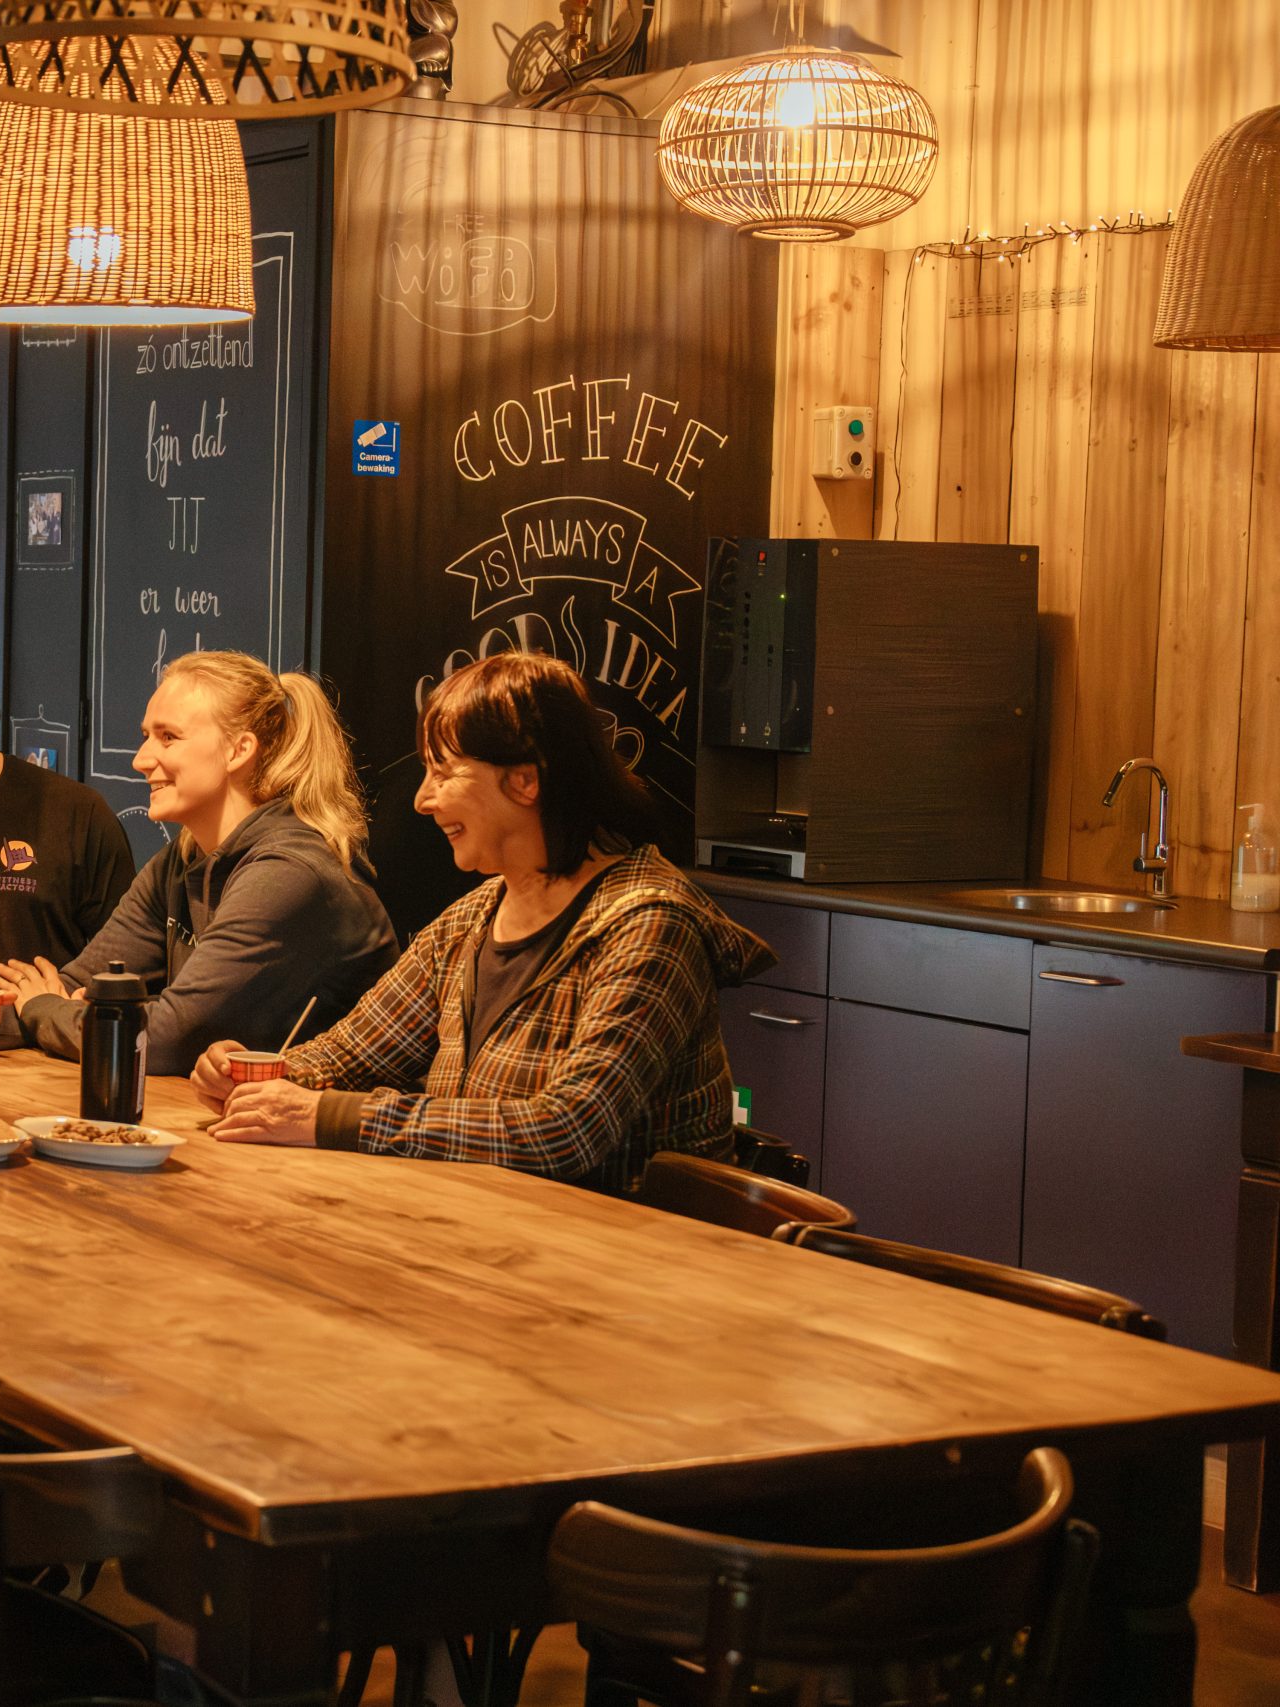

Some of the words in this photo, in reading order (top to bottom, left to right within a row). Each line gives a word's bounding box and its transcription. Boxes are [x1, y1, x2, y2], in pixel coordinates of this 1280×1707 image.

[163, 319, 254, 369] ontzettend
[192, 397, 228, 460] dat
[454, 373, 729, 501] COFFEE
[357, 463, 395, 475] bewaking
[359, 452, 394, 462] Camera-
[480, 550, 510, 592] IS
[523, 519, 625, 565] ALWAYS
[634, 566, 658, 605] A
[140, 587, 161, 615] er
[175, 586, 222, 618] weer
[595, 618, 687, 741] IDEA
